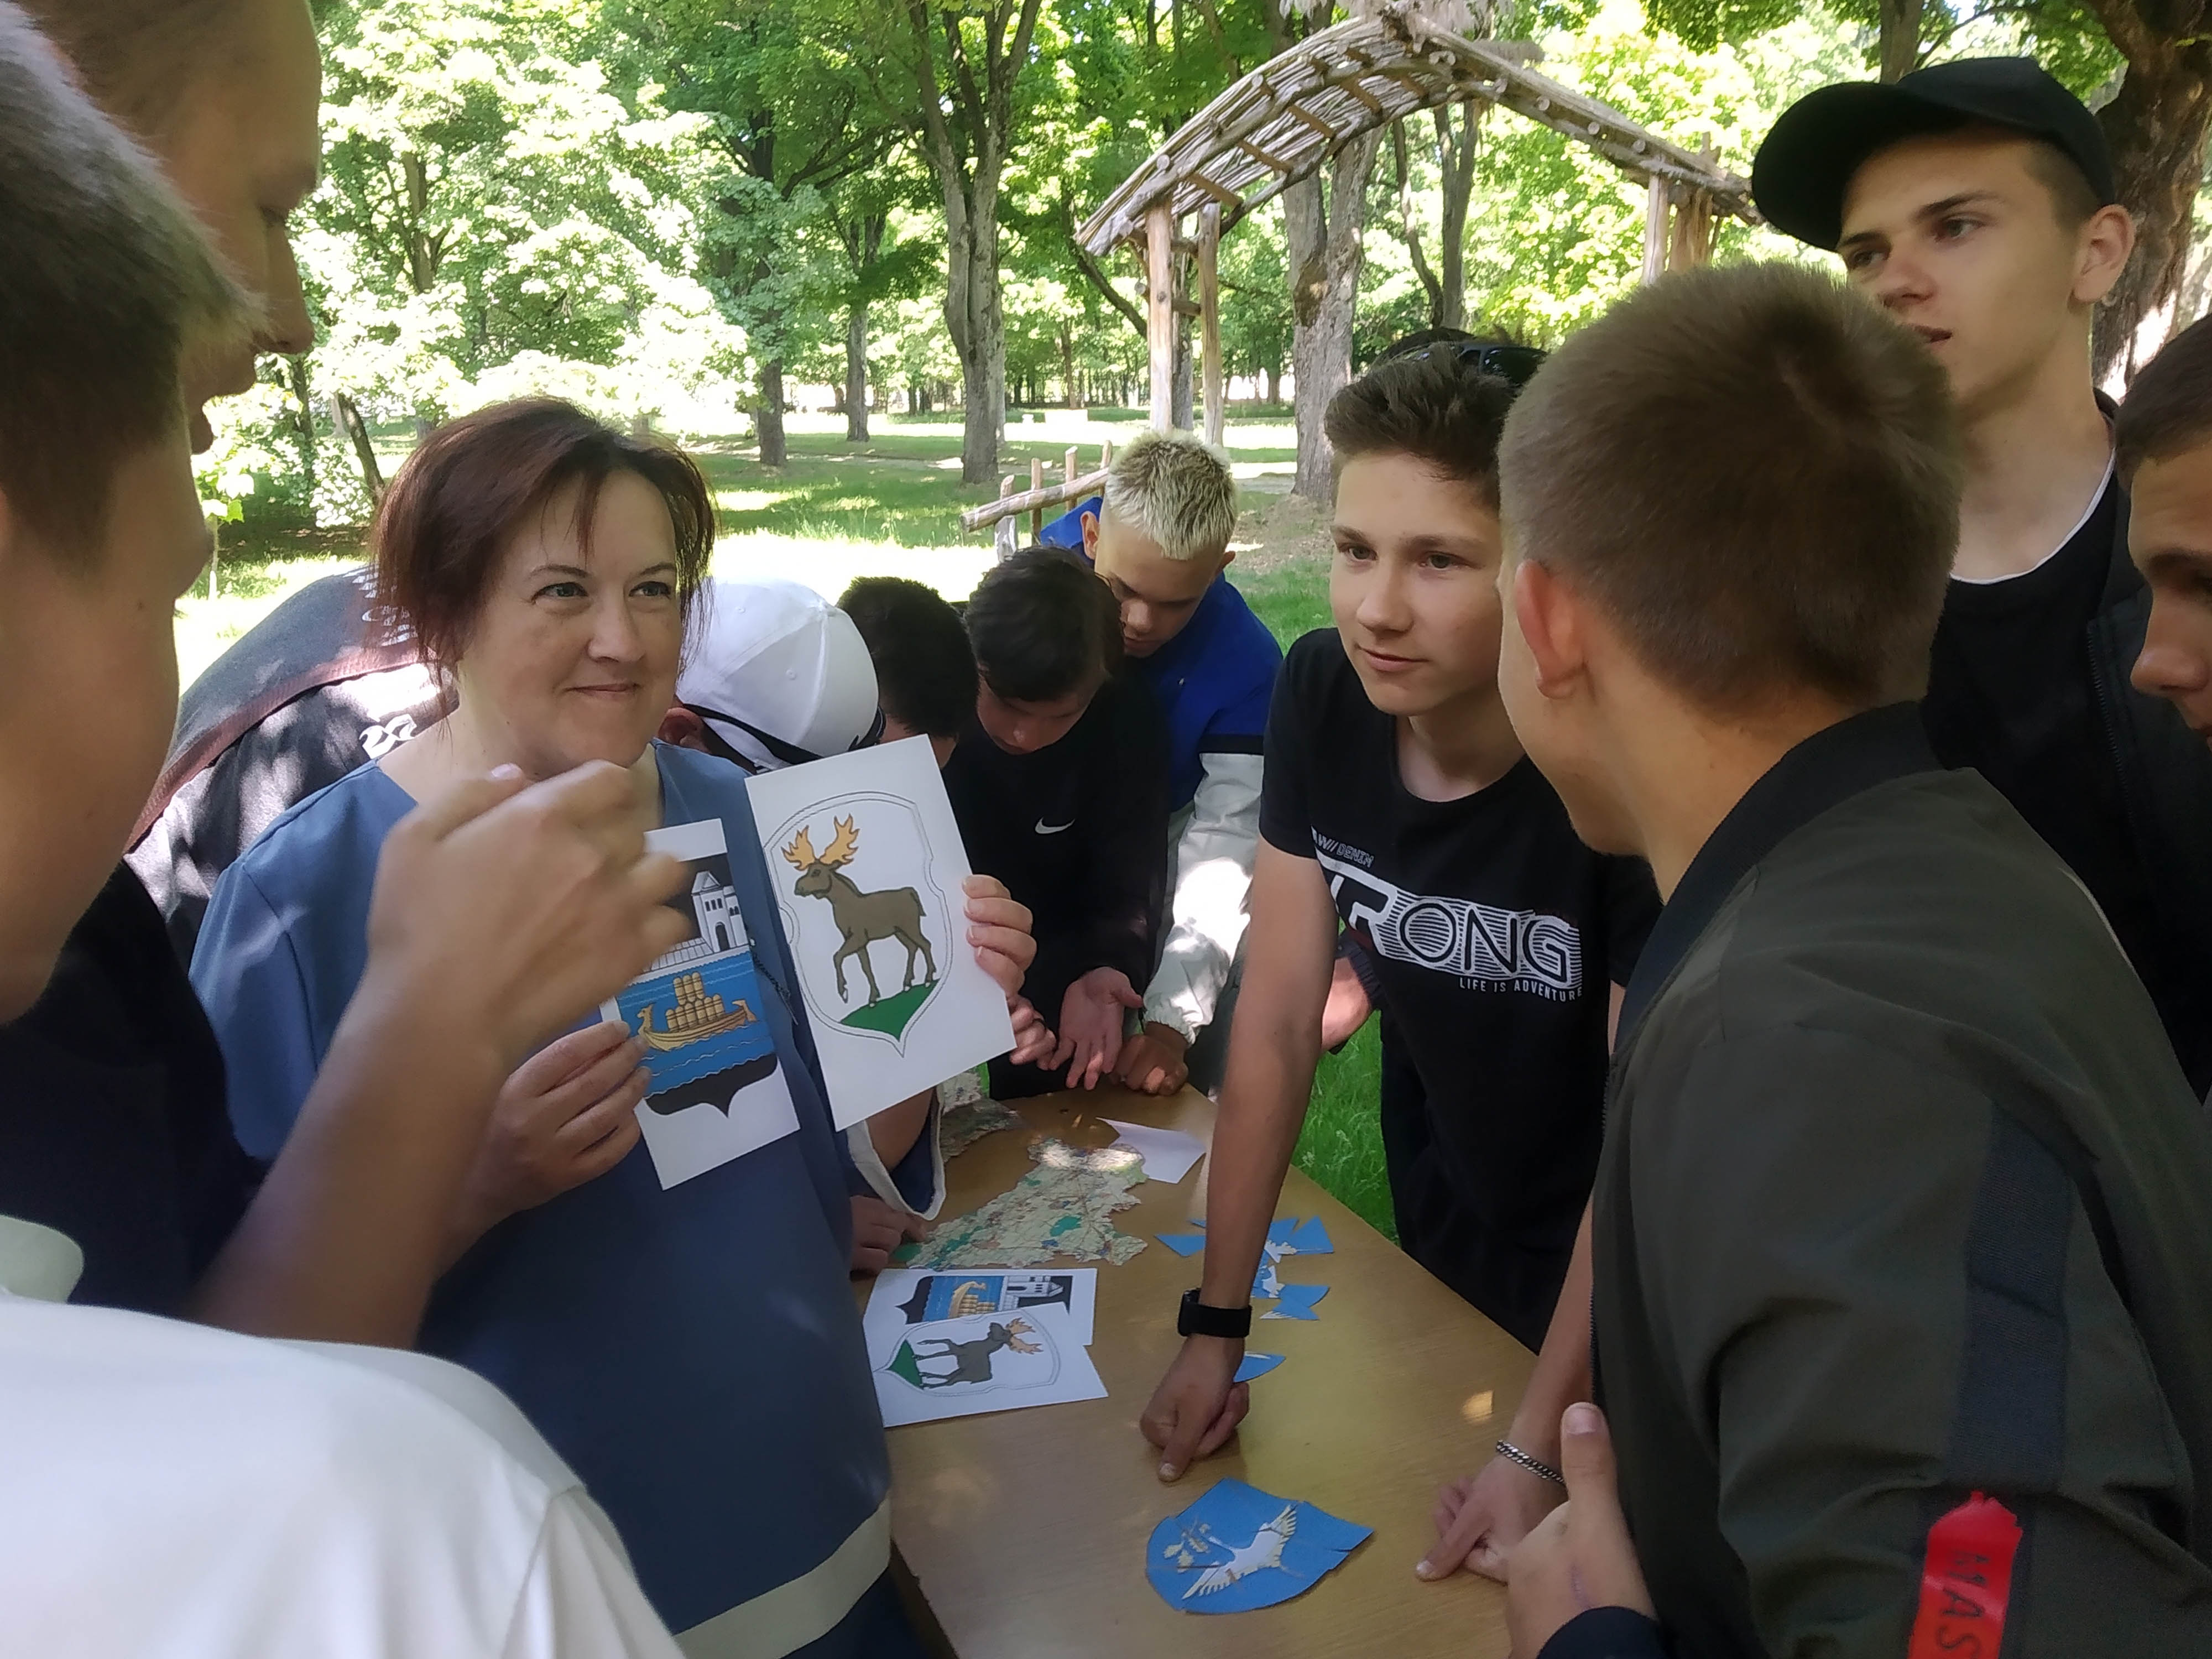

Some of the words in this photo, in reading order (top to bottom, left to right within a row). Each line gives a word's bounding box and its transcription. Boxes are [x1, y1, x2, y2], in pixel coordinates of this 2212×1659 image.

[1336, 843, 1375, 868] DENIM
[1459, 977, 1486, 992] LIFE
[1494, 982, 1506, 993] IS
[1514, 979, 1583, 1003] ADVENTURE
